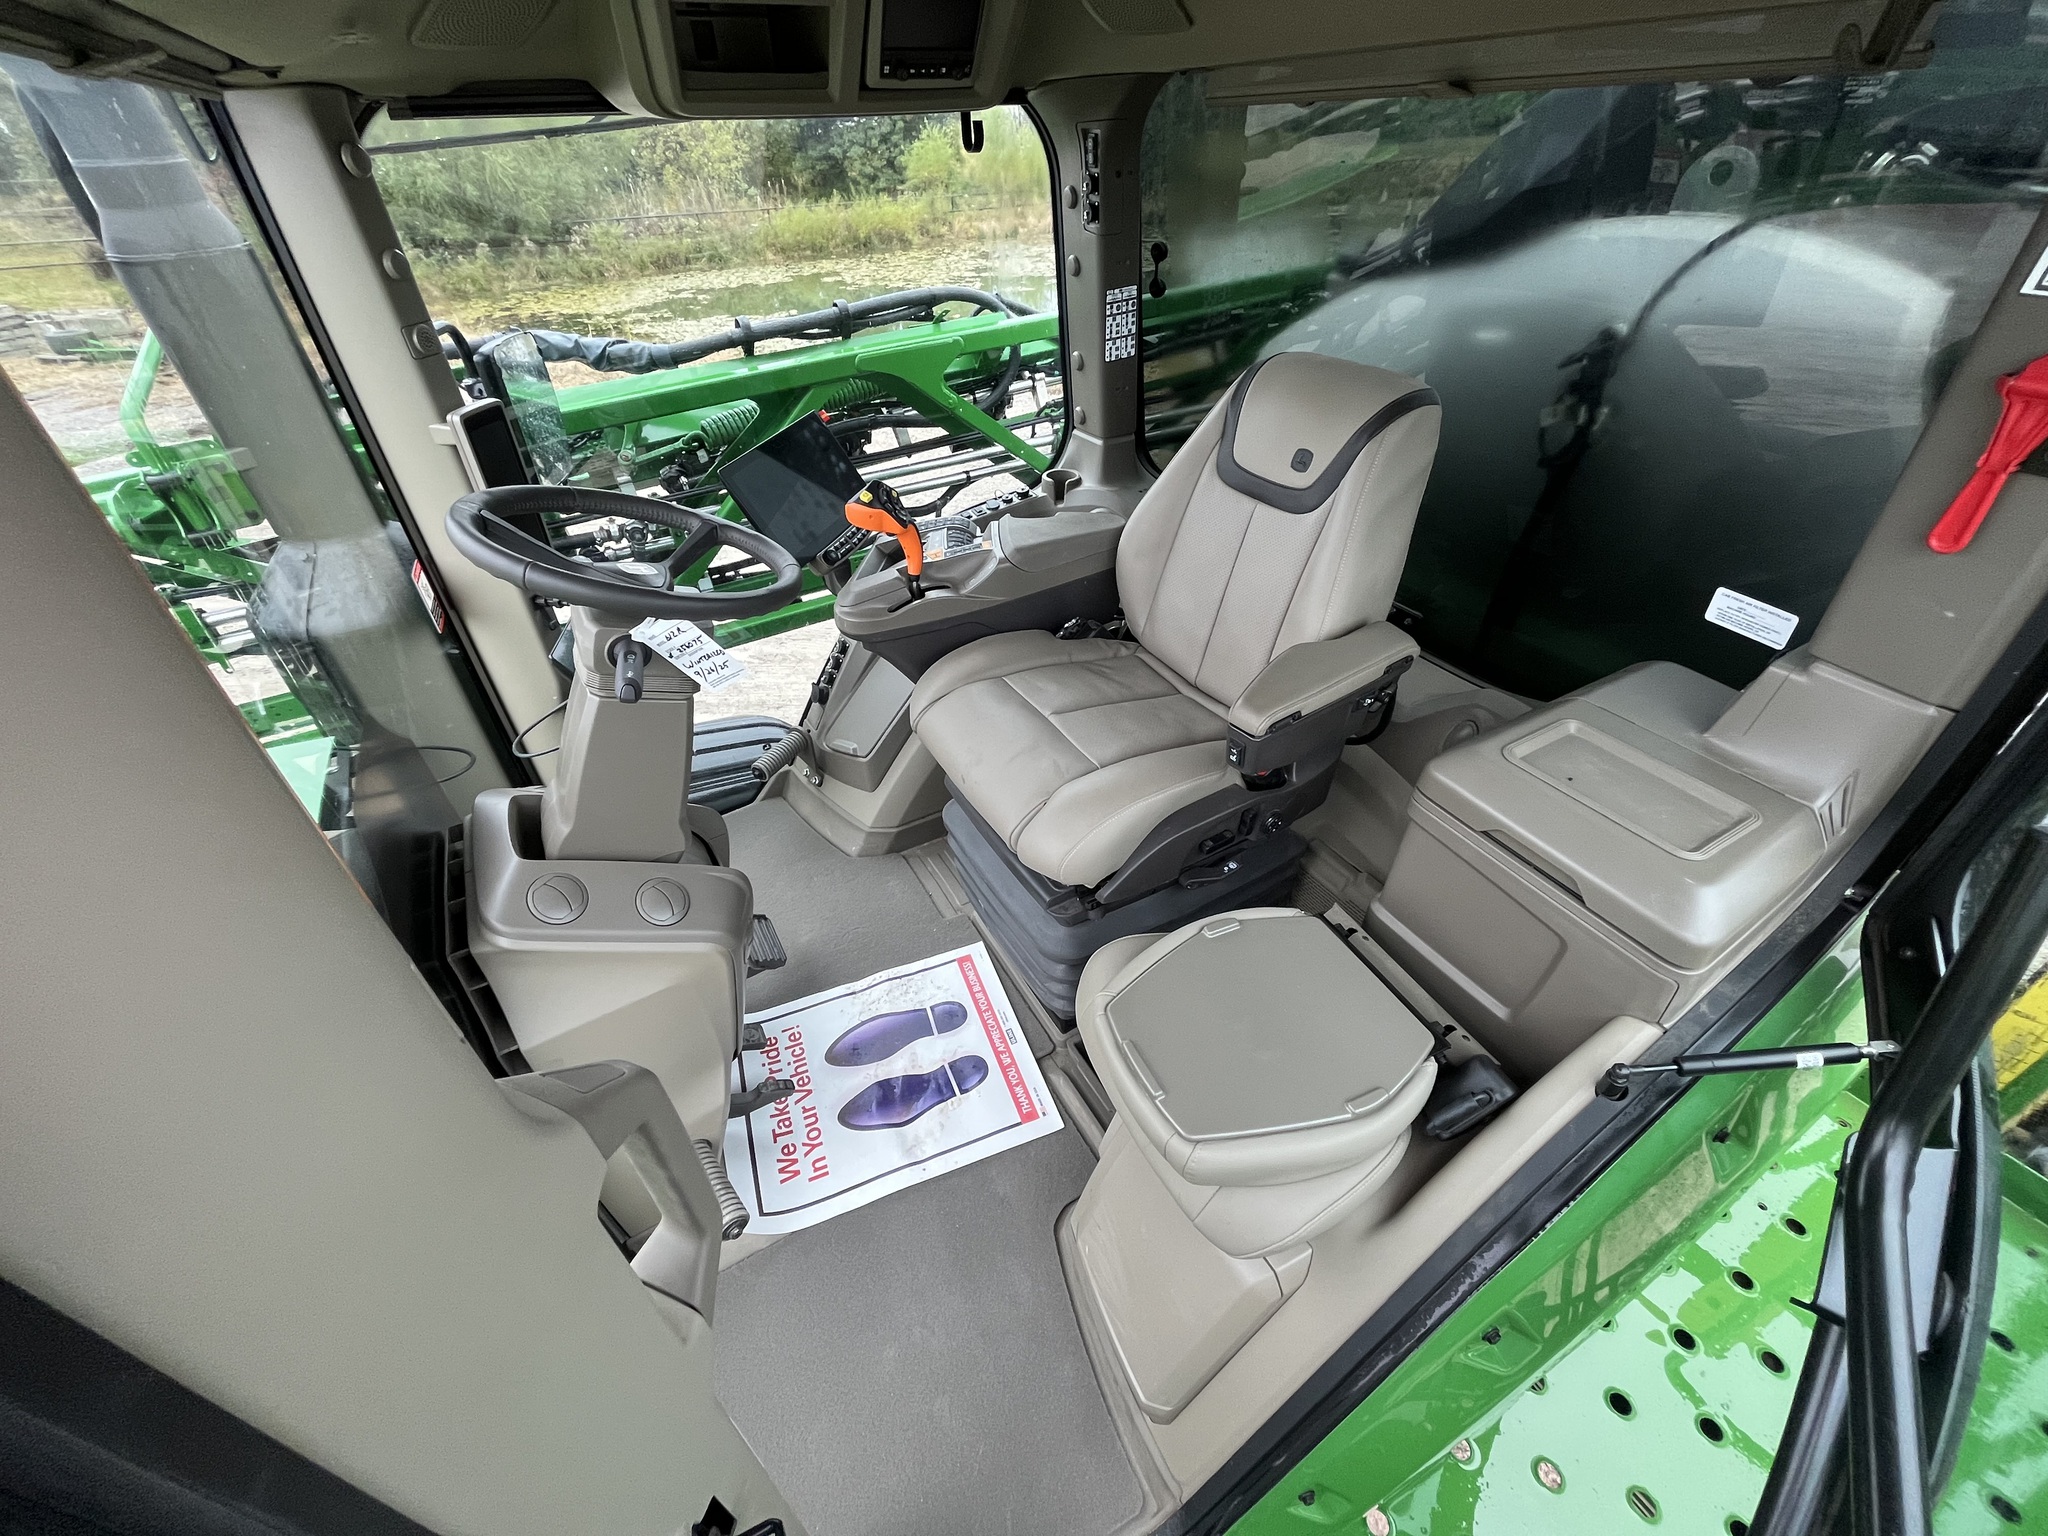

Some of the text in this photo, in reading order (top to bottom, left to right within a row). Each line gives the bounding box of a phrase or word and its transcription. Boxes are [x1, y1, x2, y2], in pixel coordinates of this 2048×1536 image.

[962, 961, 982, 993] BUSINESS!
[975, 991, 989, 1011] YOUR
[983, 1010, 1007, 1052] APPRECIATE
[1000, 1052, 1012, 1066] WE
[1006, 1065, 1020, 1086] YOU,
[781, 1024, 830, 1183] In Your Vehicle!
[1013, 1084, 1033, 1114] THANK
[776, 1143, 801, 1185] We
